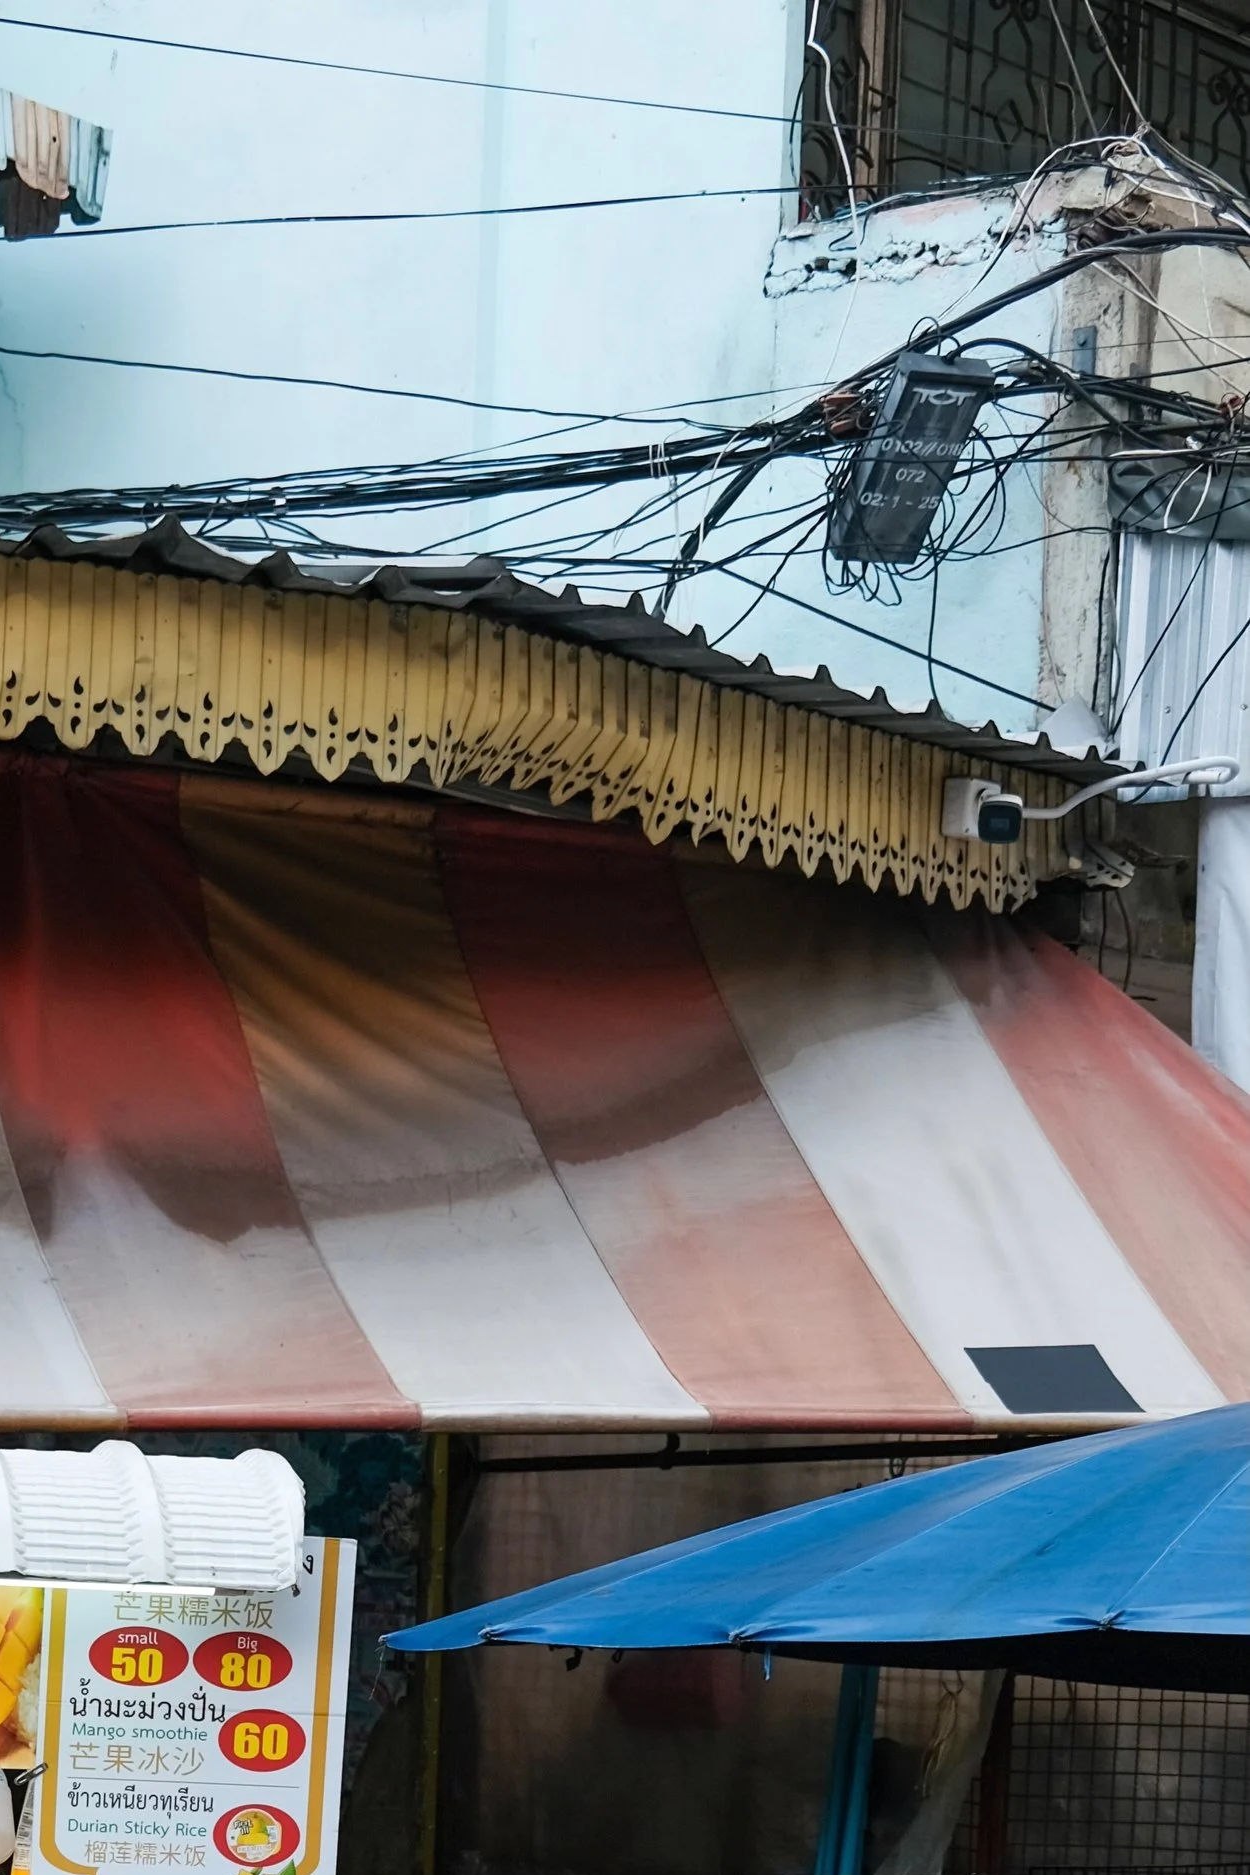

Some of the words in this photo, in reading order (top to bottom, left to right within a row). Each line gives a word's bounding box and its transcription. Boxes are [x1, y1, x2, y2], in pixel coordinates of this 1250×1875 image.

[911, 387, 977, 406] TOT
[895, 468, 927, 484] 072
[918, 496, 940, 510] 25
[112, 1592, 275, 1630] 芒果糯米饭
[117, 1631, 159, 1646] small
[236, 1636, 259, 1653] Big
[110, 1647, 164, 1684] 50
[219, 1652, 273, 1689] 80
[69, 1678, 227, 1724] น้ำมะม่วงปั่น
[72, 1722, 126, 1741] Mango
[131, 1725, 208, 1742] smoothie
[232, 1721, 289, 1761] 60
[68, 1741, 206, 1777] 芒果冰沙
[67, 1781, 215, 1820] ข้าวเหนียวทุเรียน
[67, 1818, 119, 1835] Durian
[124, 1820, 171, 1840] Sticky
[175, 1823, 208, 1838] Rice
[84, 1839, 208, 1869] 榴莲糯米饭
